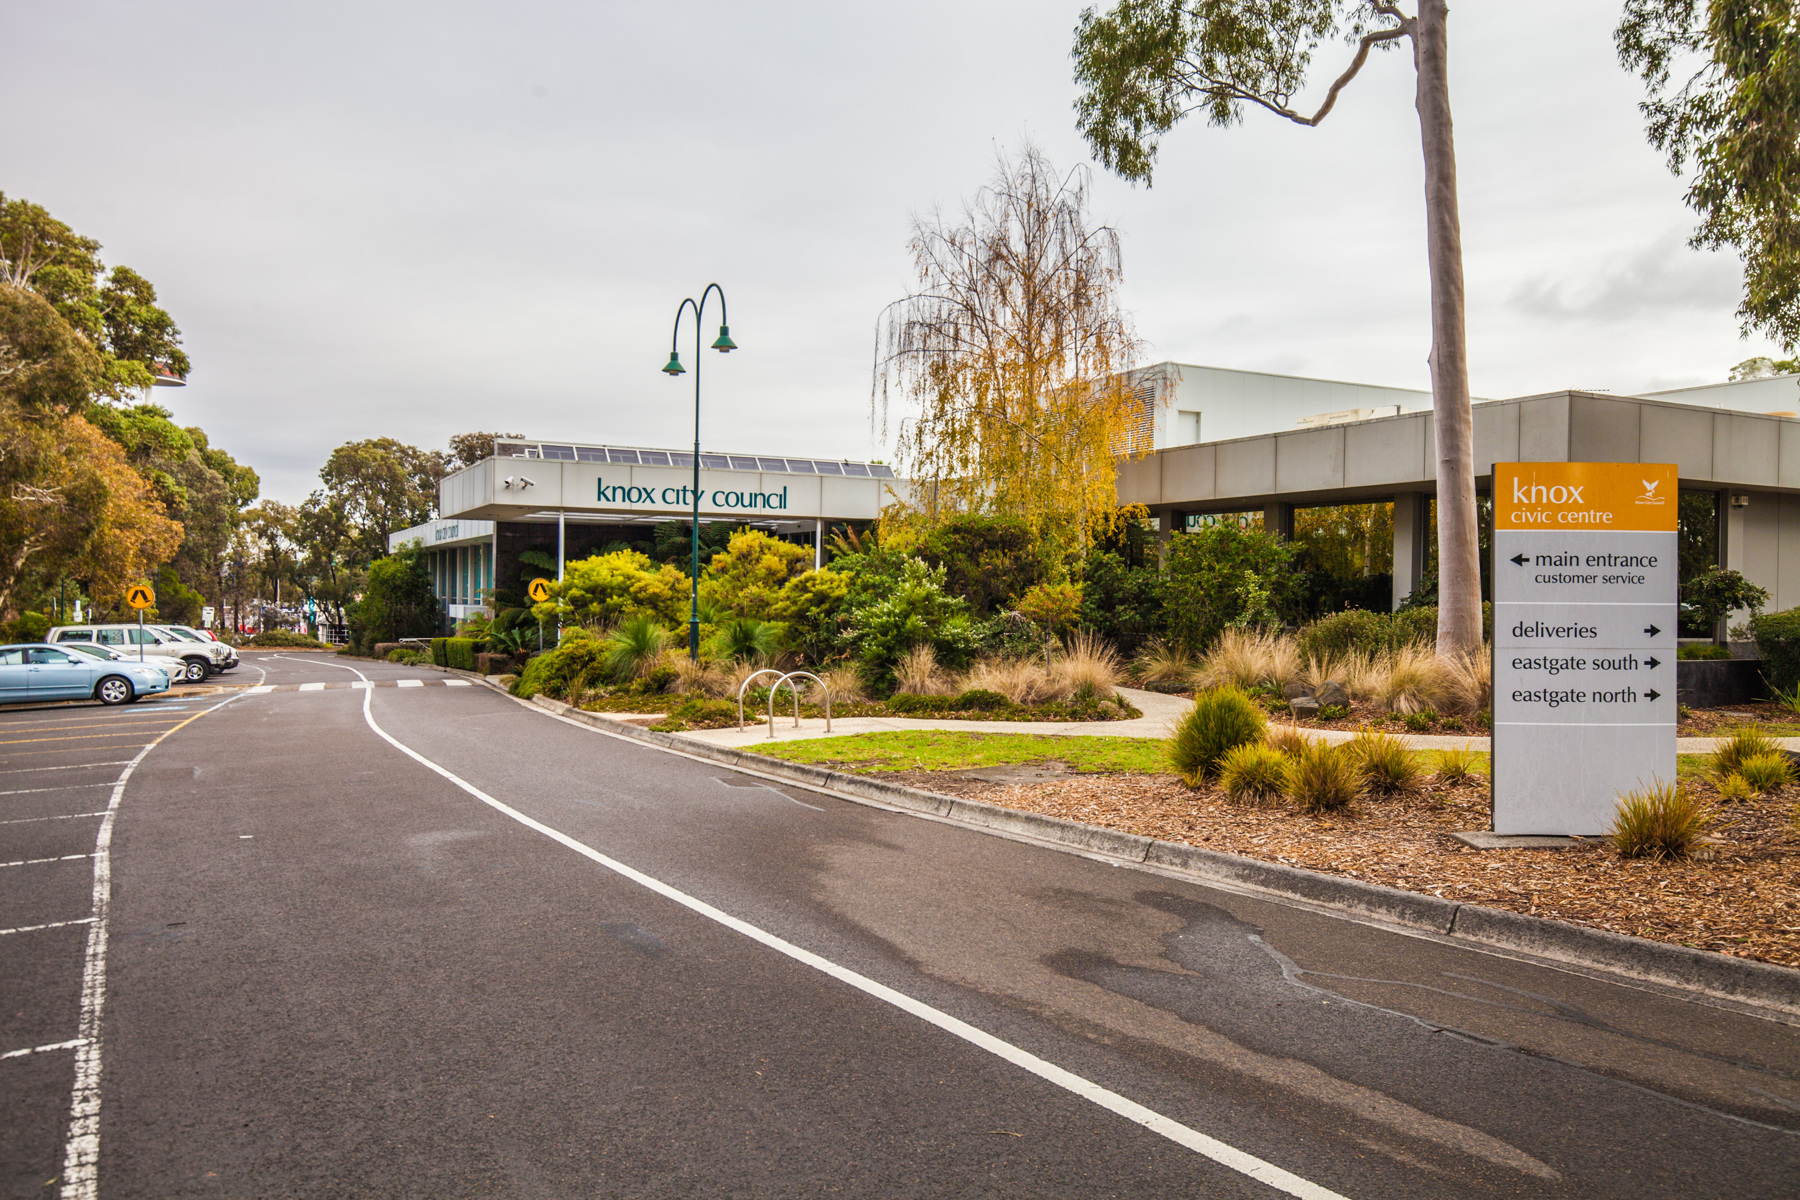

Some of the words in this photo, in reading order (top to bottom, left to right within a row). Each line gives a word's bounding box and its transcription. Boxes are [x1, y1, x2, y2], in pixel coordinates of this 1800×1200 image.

[596, 477, 656, 504] knox
[661, 485, 706, 506] city
[712, 486, 788, 510] council
[1513, 476, 1585, 504] knox
[1511, 507, 1553, 524] civic
[1557, 509, 1613, 524] centre
[1535, 551, 1580, 567] main
[1585, 553, 1658, 568] entrance
[1534, 572, 1598, 584] customer
[1602, 572, 1645, 584] service
[1512, 621, 1598, 638] deliveries
[1512, 656, 1587, 675] eastgate
[1592, 654, 1639, 671] south
[1512, 688, 1587, 708] eastgate
[1592, 686, 1637, 703] north
